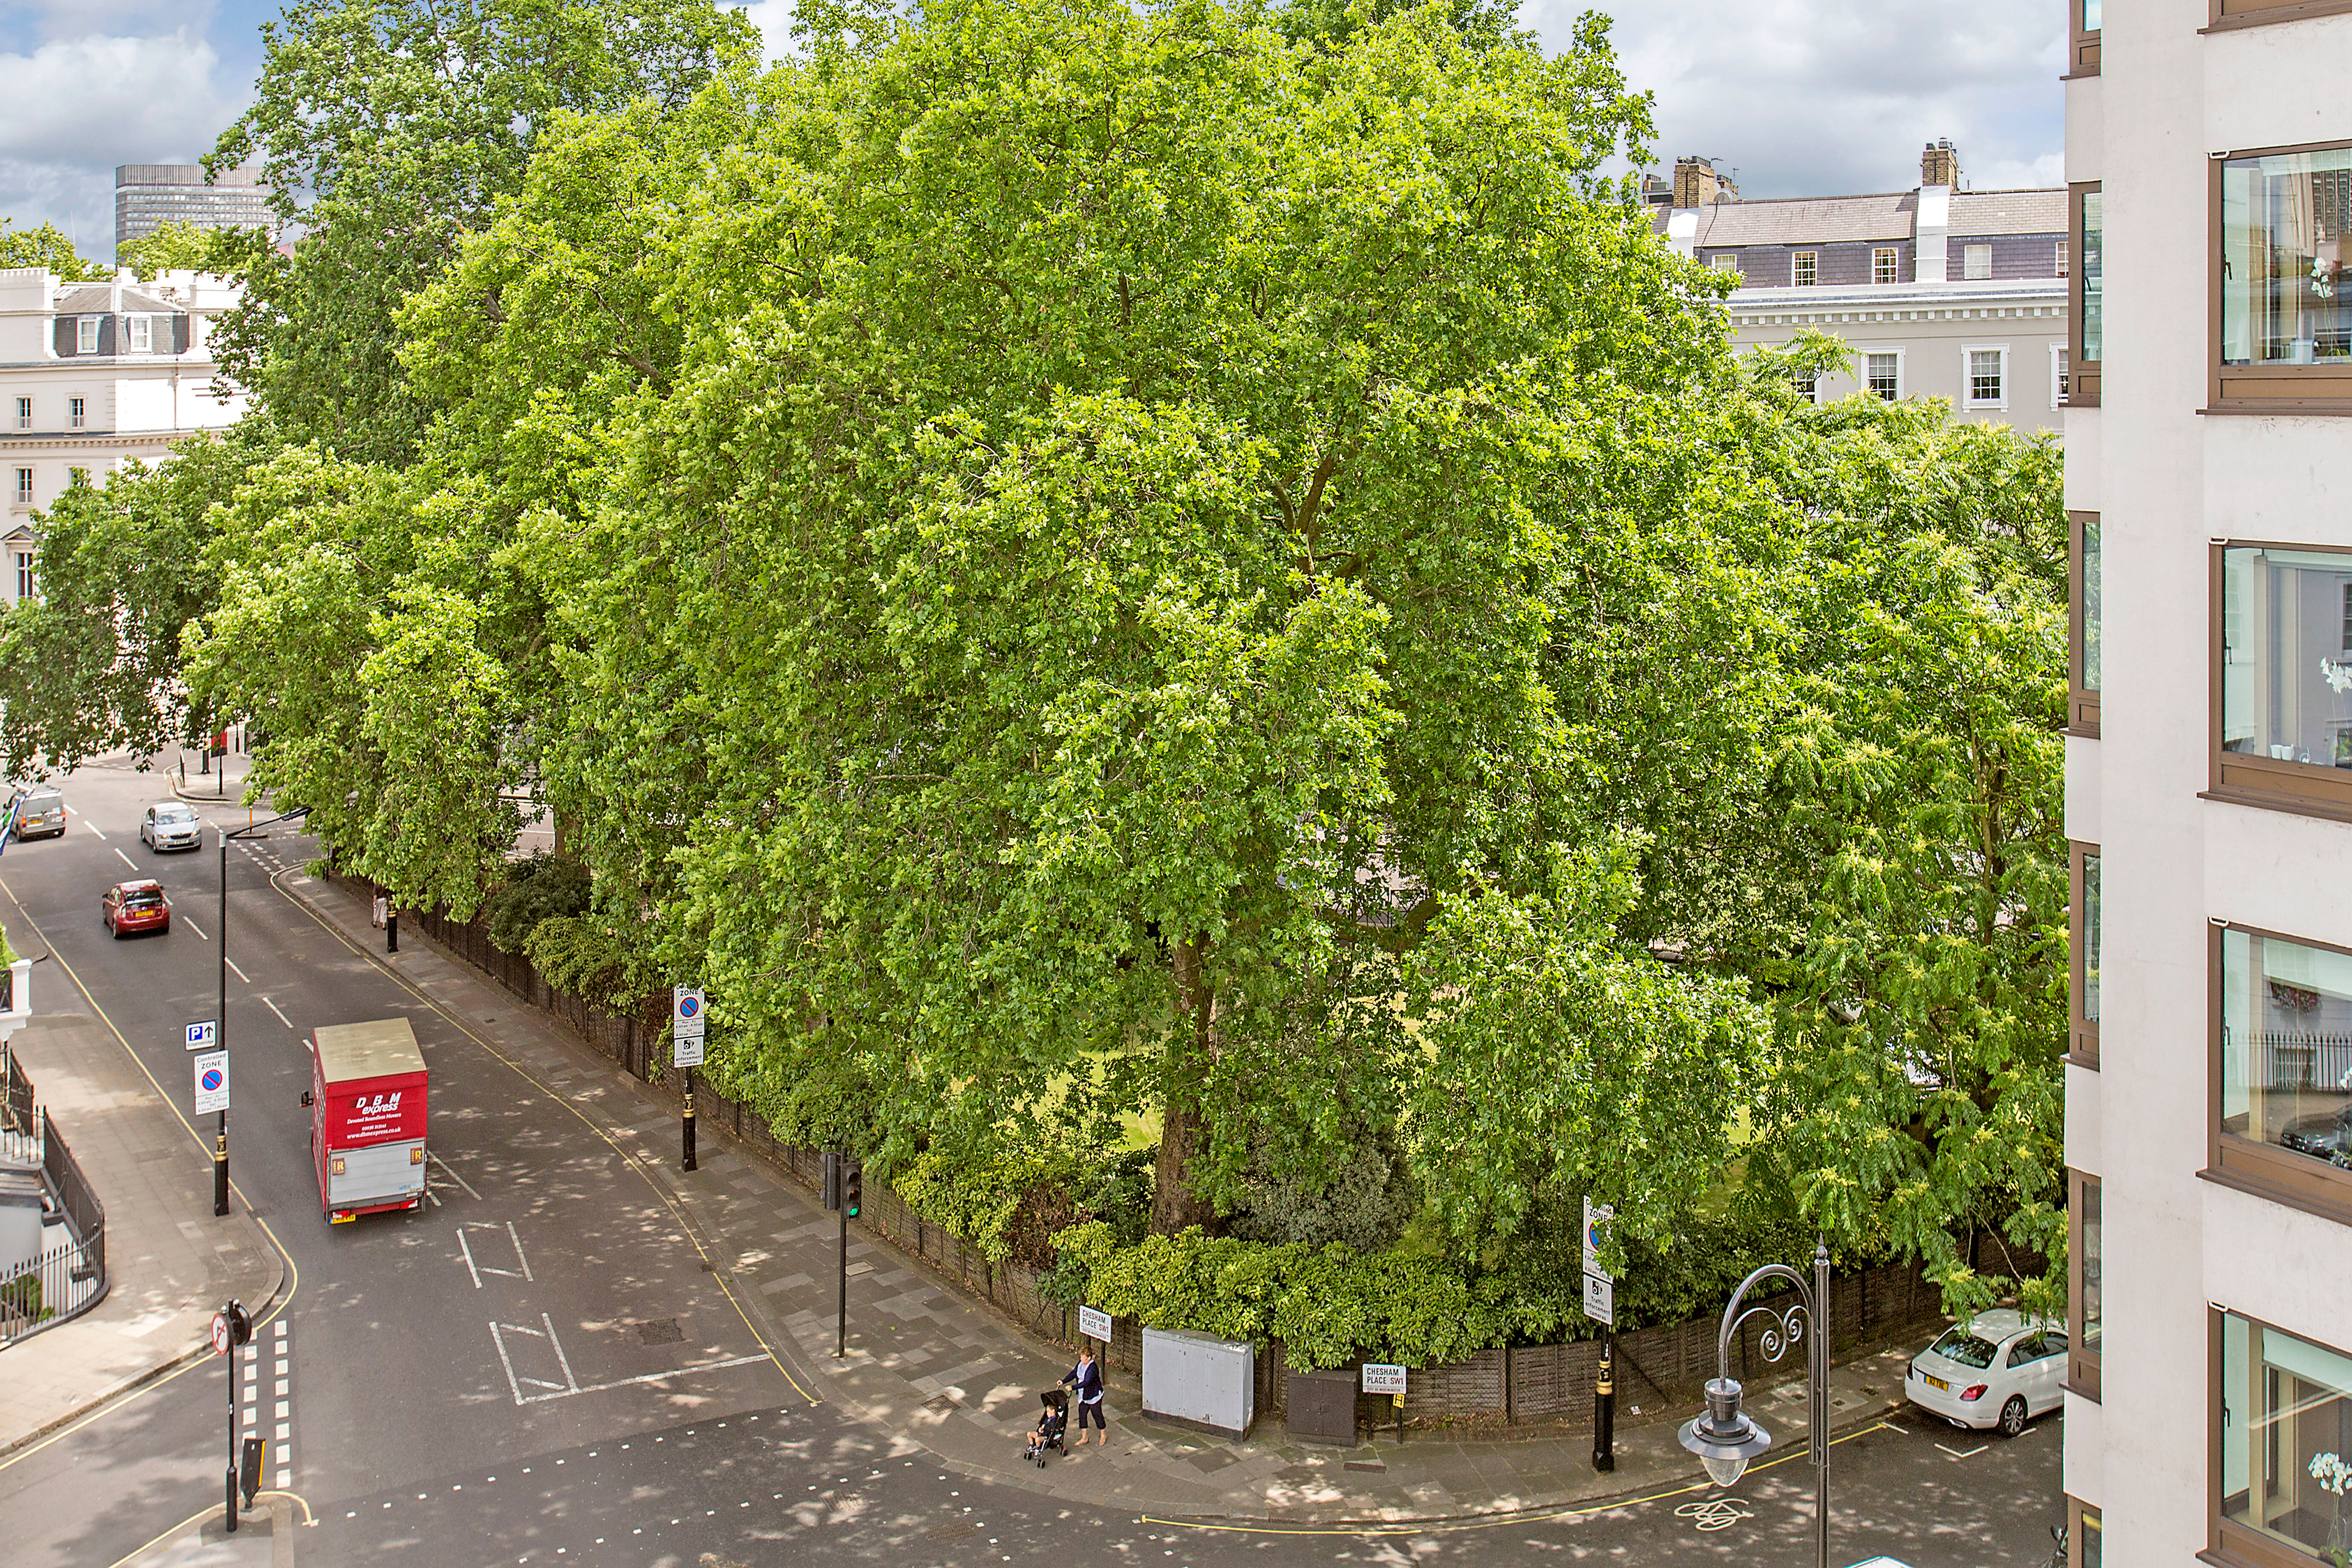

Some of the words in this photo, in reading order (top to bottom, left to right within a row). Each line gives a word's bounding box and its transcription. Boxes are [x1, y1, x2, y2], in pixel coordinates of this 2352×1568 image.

[197, 1052, 226, 1063] Controlled
[201, 1060, 222, 1069] ZONE
[362, 1103, 398, 1115] express
[347, 1126, 401, 1139] www.dbmexpress.co.uk
[1589, 1208, 1607, 1221] ZONE
[1591, 1296, 1604, 1306] Traffic
[1585, 1302, 1610, 1316] enforcement
[1589, 1310, 1606, 1320] cameras
[1083, 1309, 1106, 1324] CHESHAM
[1083, 1317, 1096, 1329] PLACE
[1099, 1323, 1109, 1333] SW1
[1367, 1367, 1399, 1376] CHESHAM
